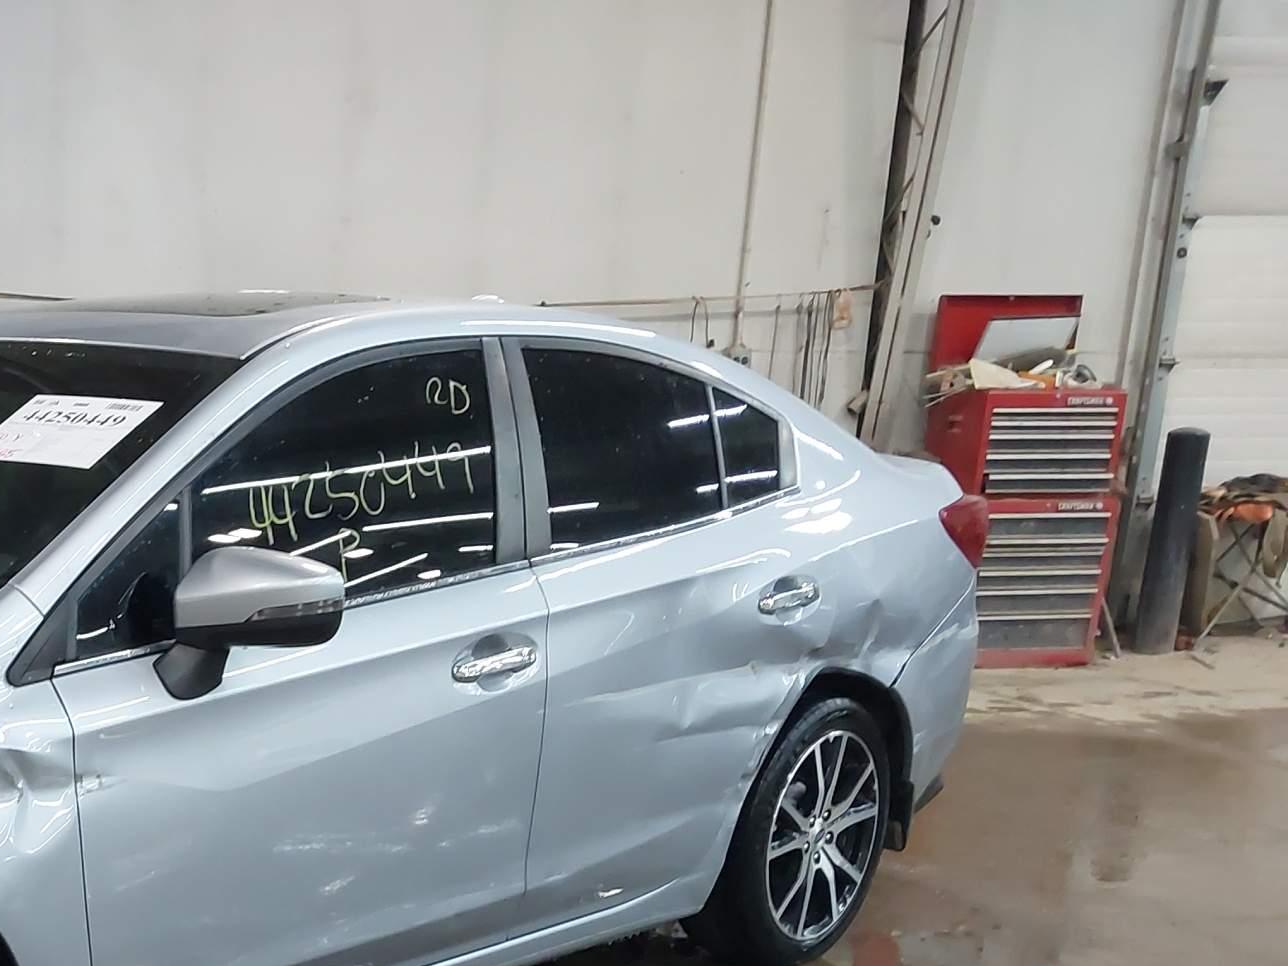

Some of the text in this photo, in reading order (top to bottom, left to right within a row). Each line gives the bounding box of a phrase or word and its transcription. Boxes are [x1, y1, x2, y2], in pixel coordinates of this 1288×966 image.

[1067, 396, 1105, 406] CRAFTSMAN
[23, 409, 127, 426] 44250449
[249, 440, 474, 545] 44250449
[1057, 501, 1095, 511] CRAFTSMAN
